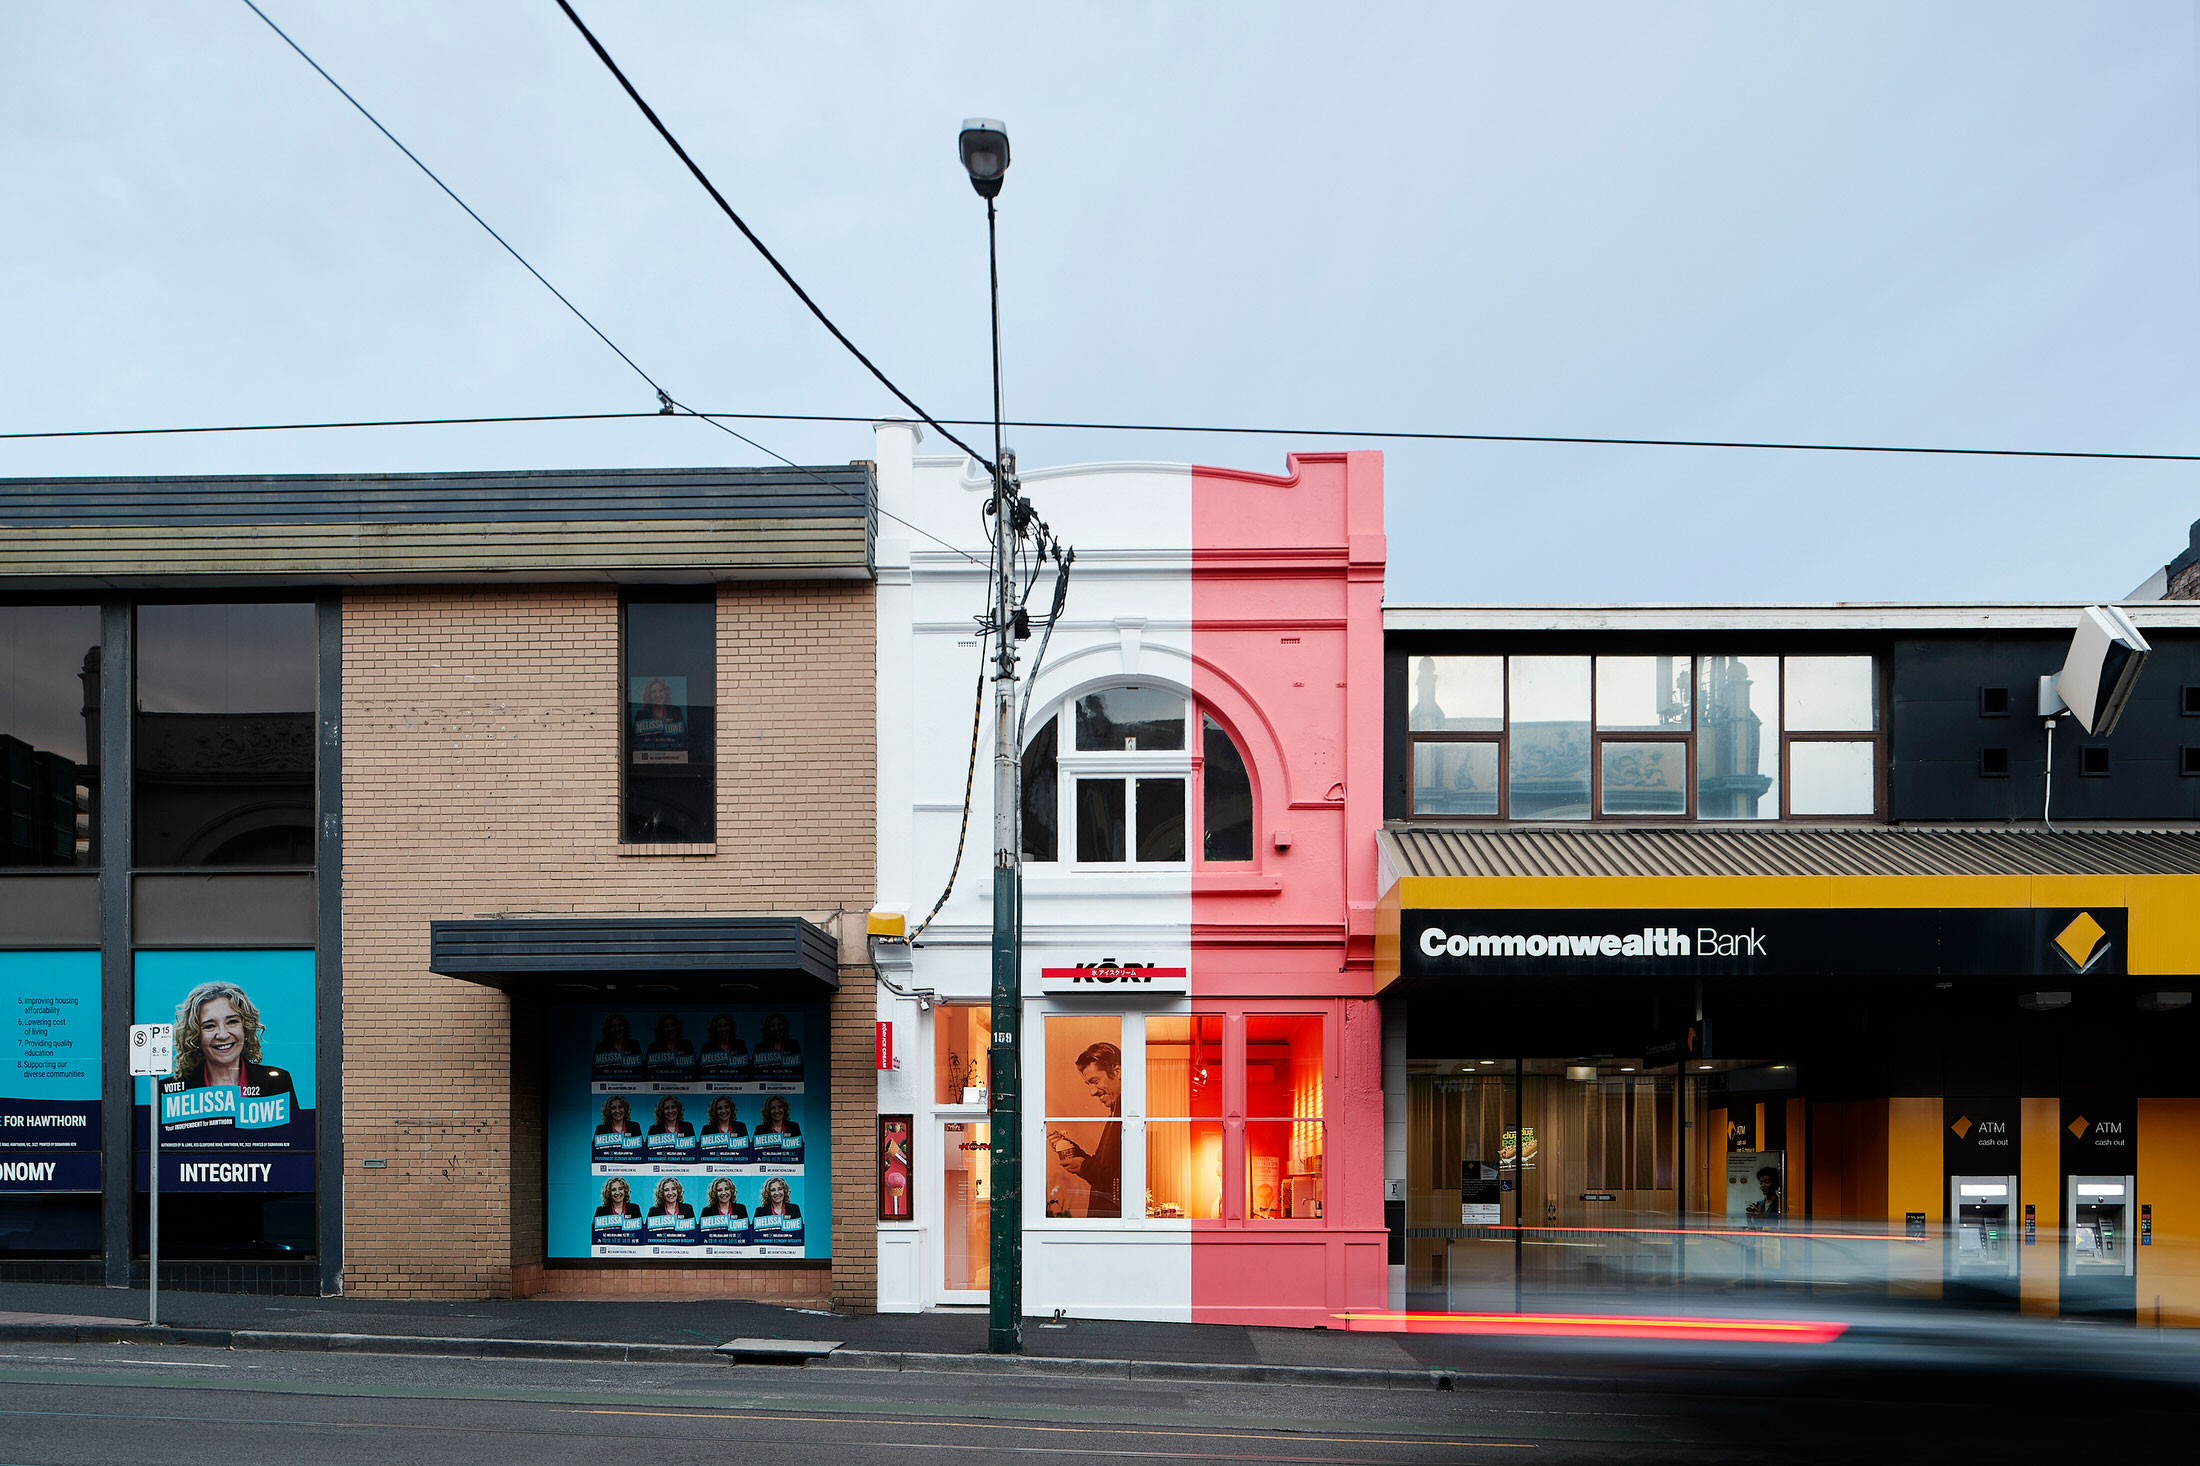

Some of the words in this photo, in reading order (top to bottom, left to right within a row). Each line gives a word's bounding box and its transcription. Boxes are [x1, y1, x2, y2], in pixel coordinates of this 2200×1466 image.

[1420, 927, 1691, 957] Commonwealth
[1698, 927, 1768, 957] Bank
[18, 996, 24, 1005] 5.
[24, 997, 54, 1006] Improving
[55, 997, 79, 1006] housing
[24, 1006, 60, 1015] affordability
[17, 1018, 24, 1026] 6.
[24, 1018, 52, 1028] Lowering
[52, 1018, 66, 1026] cost
[32, 1028, 48, 1037] living
[152, 1027, 160, 1039] P
[18, 1039, 24, 1047] 7.
[24, 1039, 52, 1048] Providing
[53, 1039, 74, 1048] quality
[24, 1049, 54, 1057] education
[17, 1060, 23, 1068] 8.
[23, 1060, 57, 1070] Supporting
[23, 1070, 46, 1078] diverse
[46, 1070, 85, 1078] communities
[164, 1082, 182, 1093] VOTE
[242, 1086, 260, 1096] 2022
[166, 1090, 236, 1118] MELISSA
[240, 1098, 285, 1124] LOWE
[4, 1115, 25, 1127] FOR
[26, 1115, 87, 1127] HAWTHORN
[1978, 1121, 2005, 1133] ATM
[2095, 1121, 2122, 1133] ATM
[596, 1134, 622, 1145] MELISSA
[623, 1137, 640, 1147] LOWE
[649, 1134, 675, 1145] MELISSA
[676, 1137, 693, 1147] LOWE
[702, 1134, 728, 1145] MELISSA
[729, 1137, 747, 1147] LOWE
[755, 1134, 782, 1145] MELISSA
[782, 1137, 800, 1147] LOWE
[0, 1162, 56, 1181] NOMY
[180, 1163, 272, 1182] INTEGRITY
[596, 1215, 622, 1227] MELISSA
[623, 1219, 640, 1230] LOWE
[649, 1215, 675, 1227] MELISSA
[676, 1219, 693, 1230] LOWE
[702, 1215, 728, 1227] MELISSA
[729, 1219, 747, 1230] LOWE
[755, 1215, 782, 1227] MELISSA
[782, 1219, 800, 1230] LOWE
